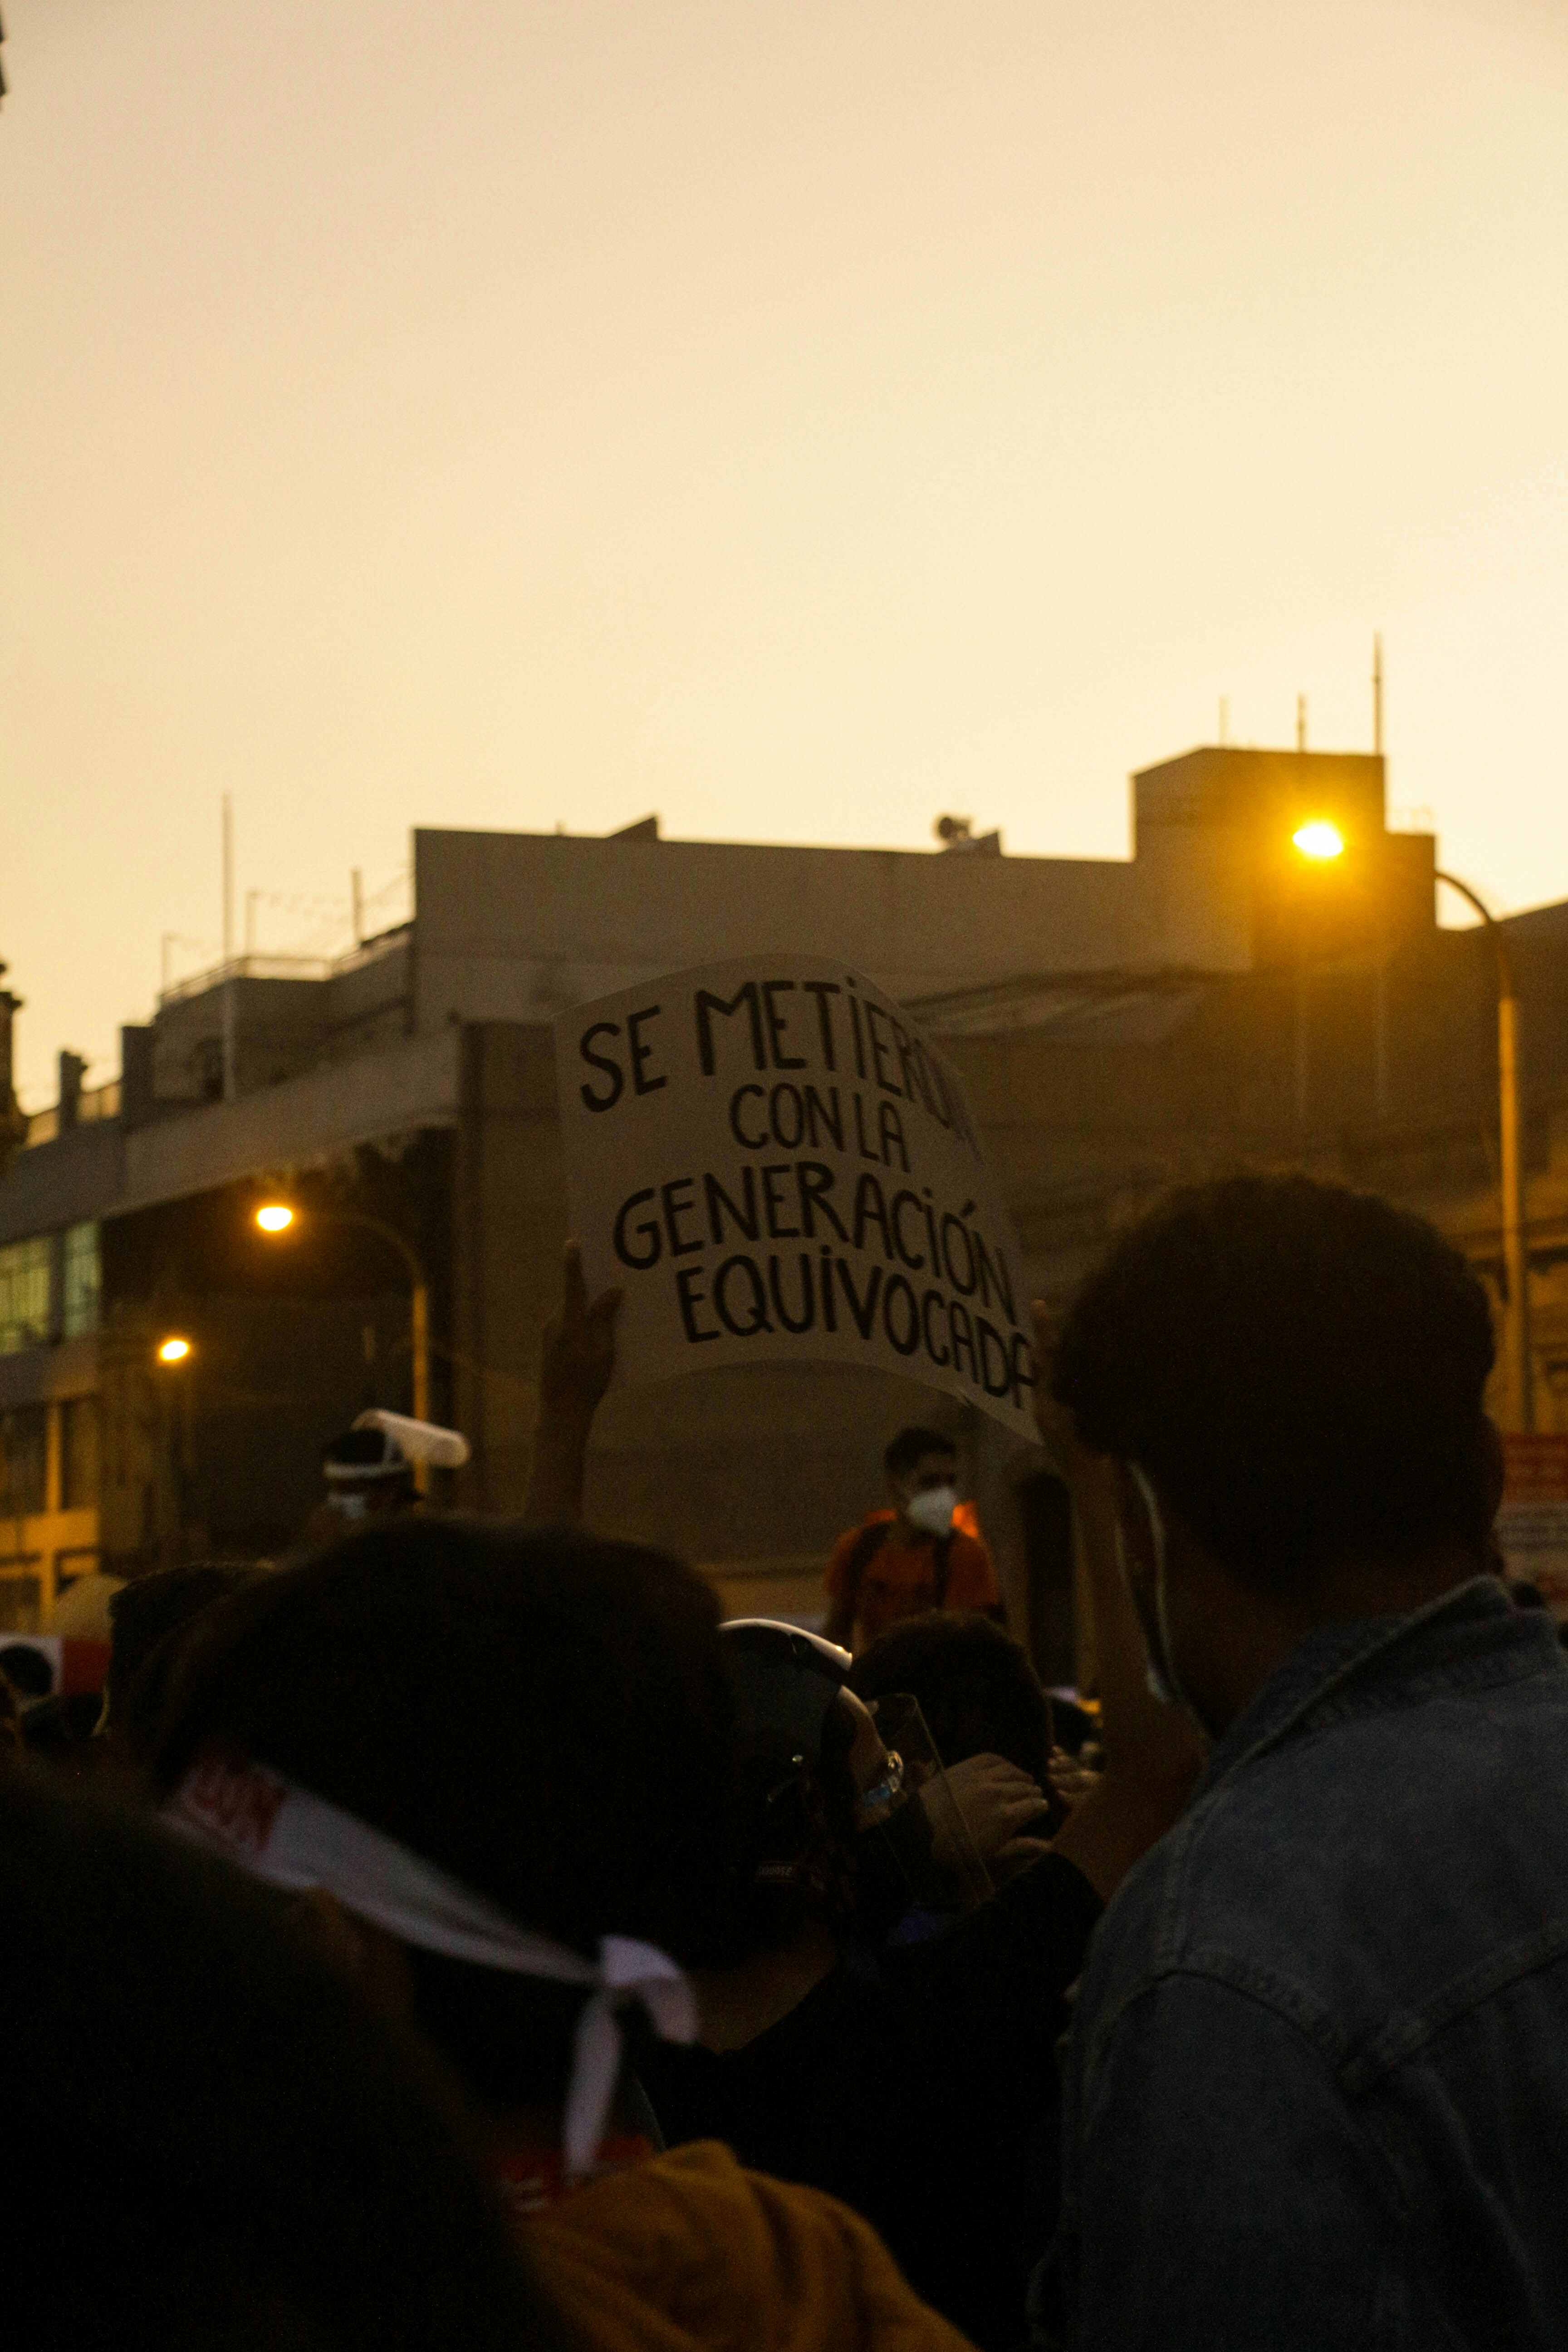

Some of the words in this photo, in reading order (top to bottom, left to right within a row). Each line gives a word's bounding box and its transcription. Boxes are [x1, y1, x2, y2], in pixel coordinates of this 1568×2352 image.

[579, 1004, 667, 1112] SE
[730, 1082, 845, 1152] CON
[853, 1092, 911, 1173] LA
